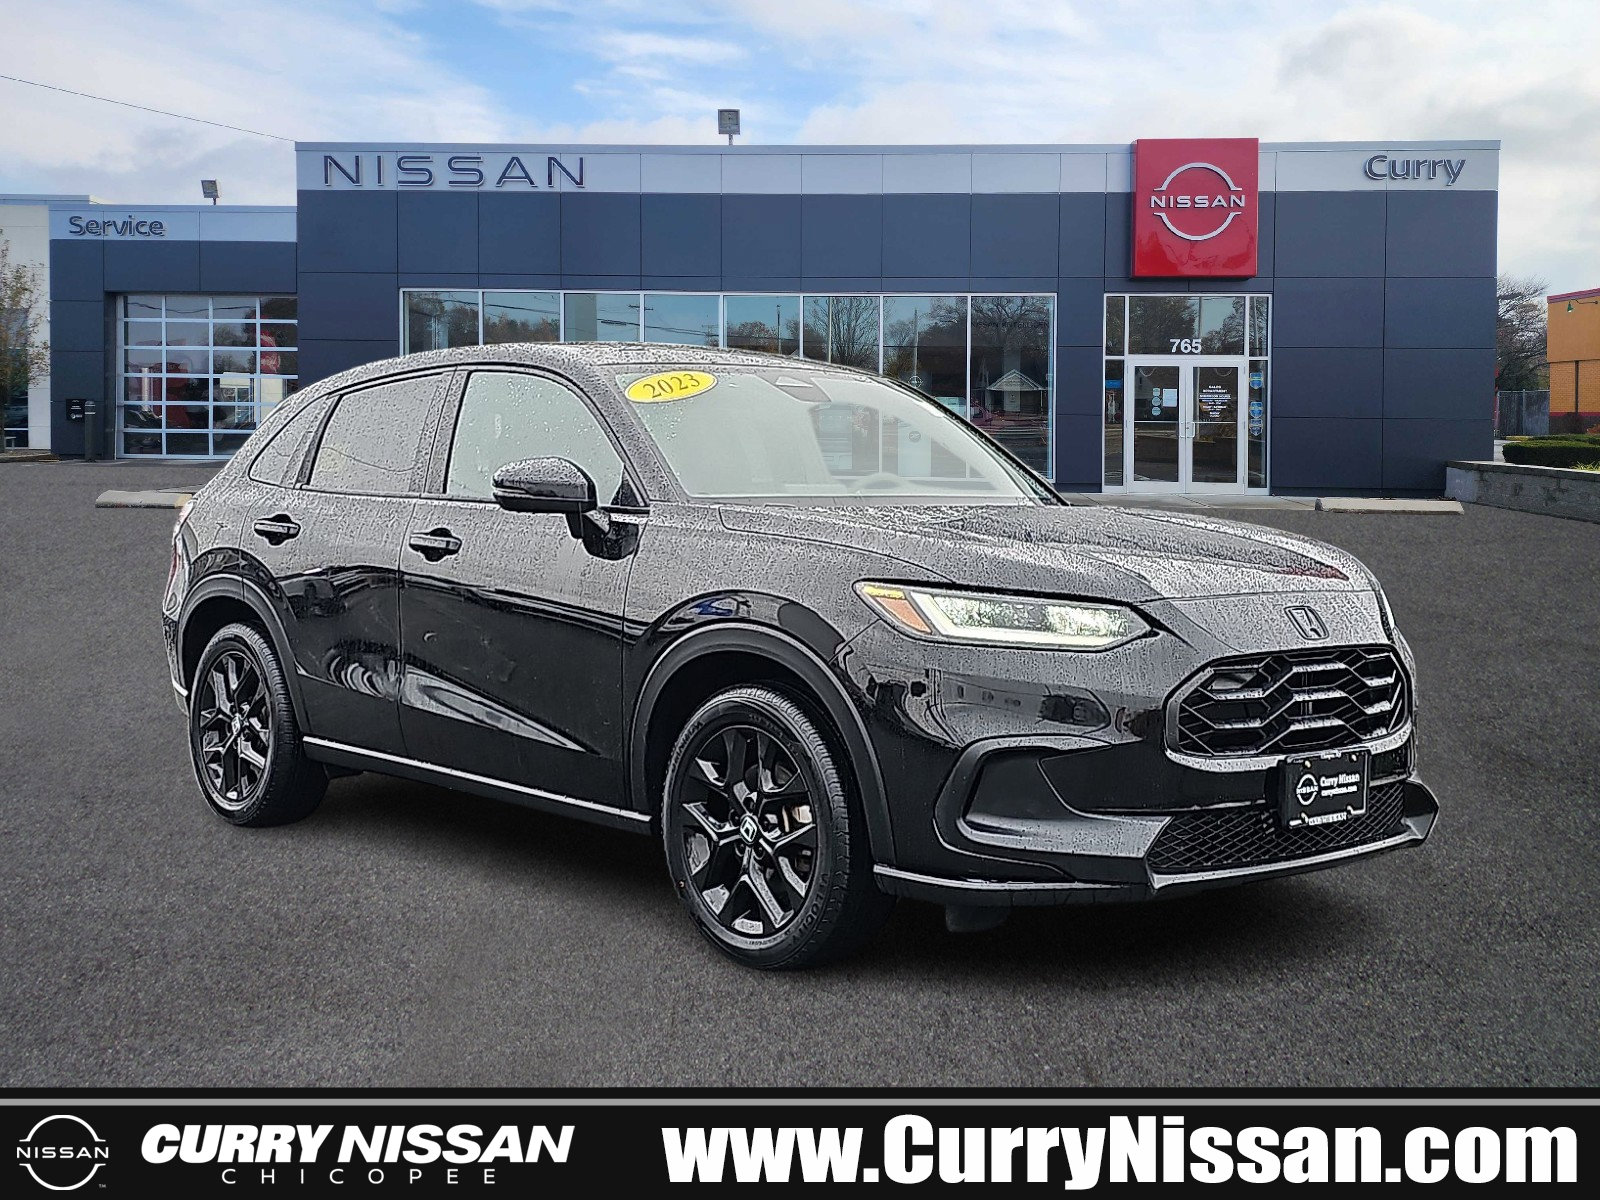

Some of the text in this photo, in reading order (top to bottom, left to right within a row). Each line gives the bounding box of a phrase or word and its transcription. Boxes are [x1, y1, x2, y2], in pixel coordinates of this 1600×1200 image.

[323, 154, 586, 188] NISSAN
[1364, 154, 1467, 187] Curry
[1150, 194, 1246, 210] NISSAN
[68, 214, 166, 237] Service
[1169, 338, 1203, 354] 765
[642, 373, 701, 399] 2023
